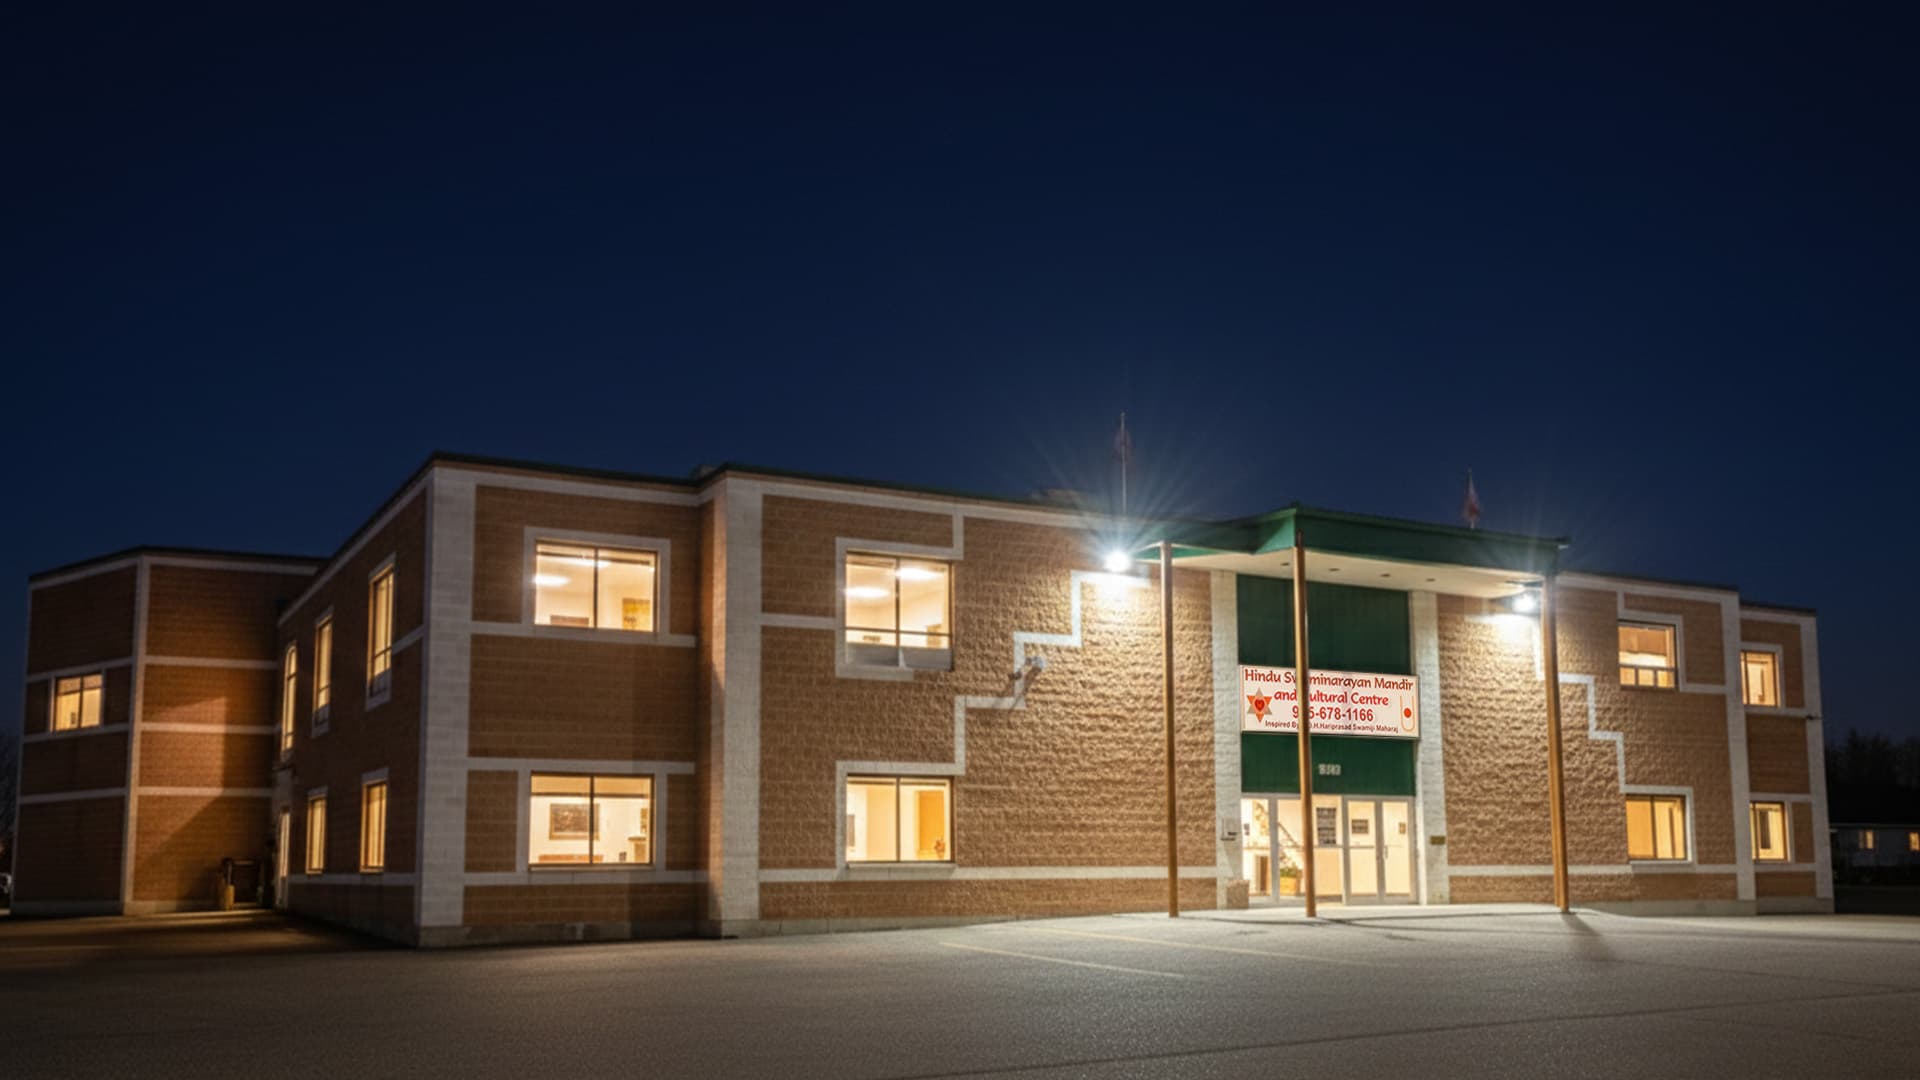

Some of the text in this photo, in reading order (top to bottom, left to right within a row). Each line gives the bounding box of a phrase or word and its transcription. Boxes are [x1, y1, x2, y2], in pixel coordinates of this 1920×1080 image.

[1245, 669, 1413, 690] Hindu Sminarayan Mandir
[1274, 689, 1389, 706] and ultural Centre
[1292, 705, 1373, 721] 95-678-1166
[1265, 720, 1290, 729] Inspired
